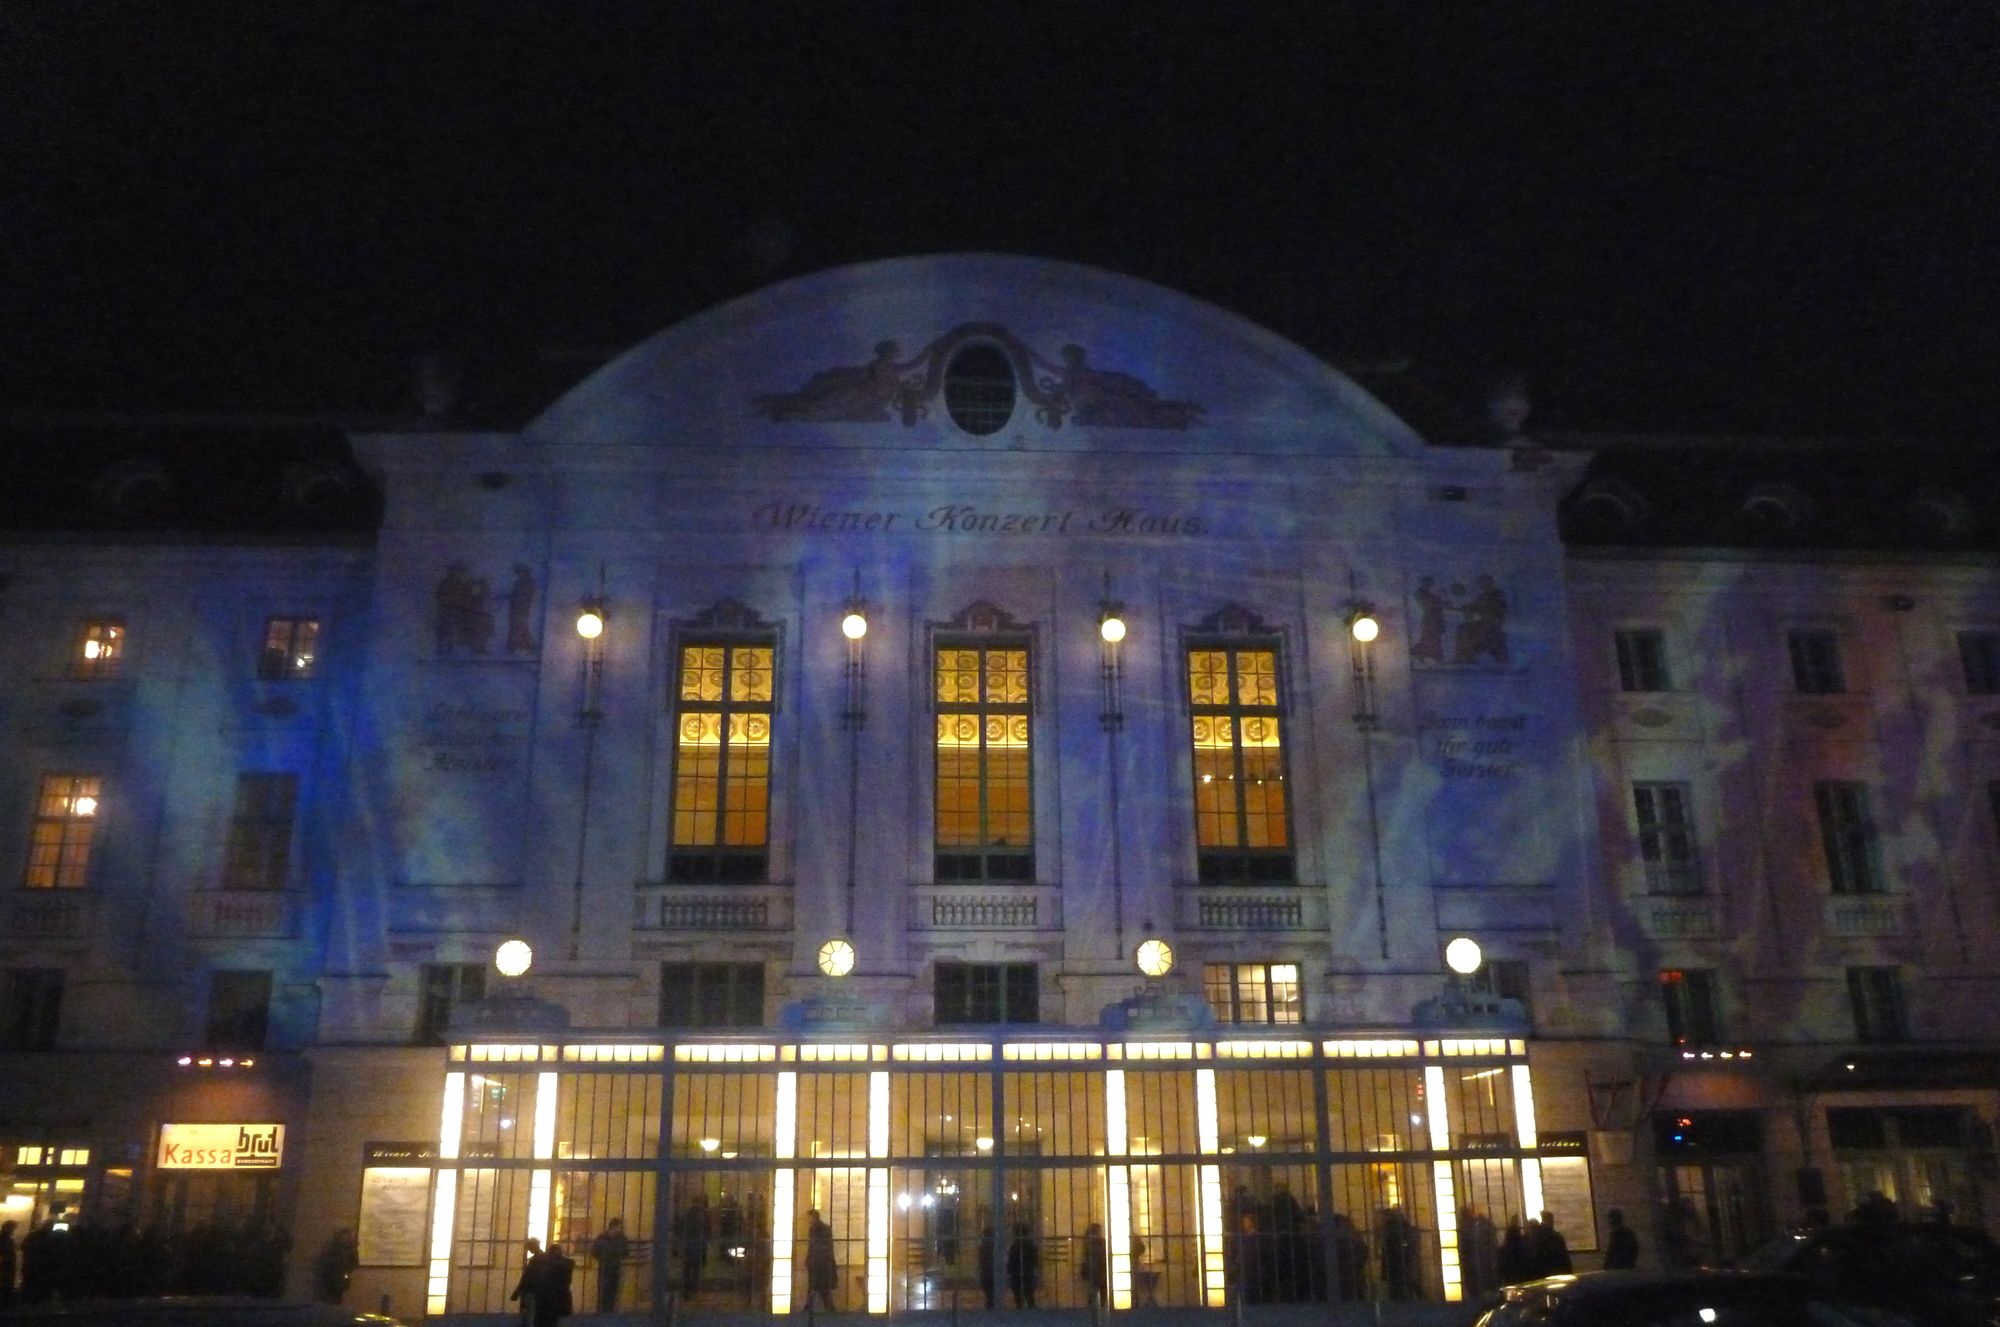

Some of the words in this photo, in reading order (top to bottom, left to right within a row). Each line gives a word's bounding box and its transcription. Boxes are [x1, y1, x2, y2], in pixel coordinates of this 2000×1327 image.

[753, 503, 902, 532] Wiener
[914, 504, 1069, 533] Konzert
[165, 1143, 231, 1164] Kassa
